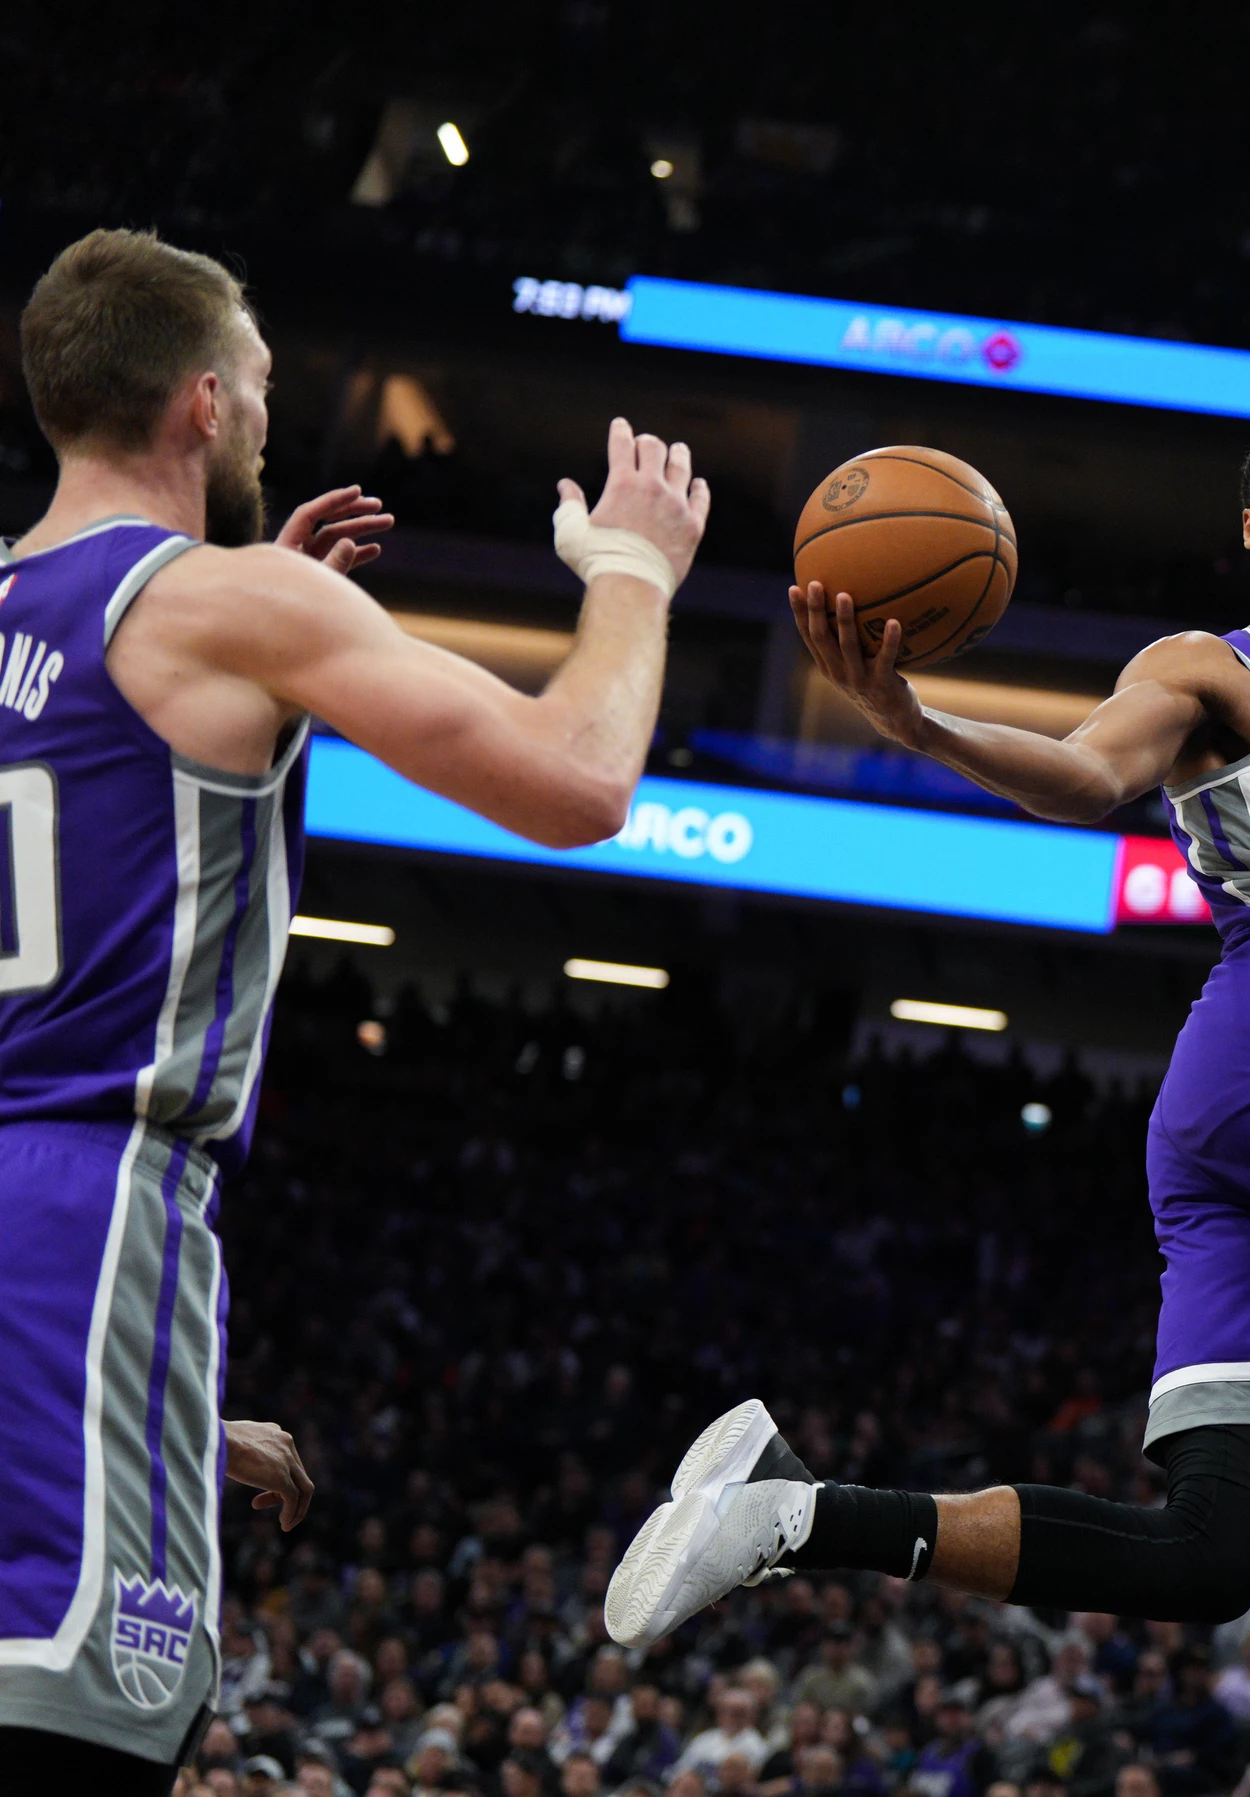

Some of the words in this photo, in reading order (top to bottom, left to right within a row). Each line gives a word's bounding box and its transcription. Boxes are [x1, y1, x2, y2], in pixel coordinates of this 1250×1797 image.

[839, 313, 974, 364] ARCO
[0, 631, 64, 721] NIS
[614, 801, 753, 864] RCO
[115, 1618, 189, 1664] SAC
